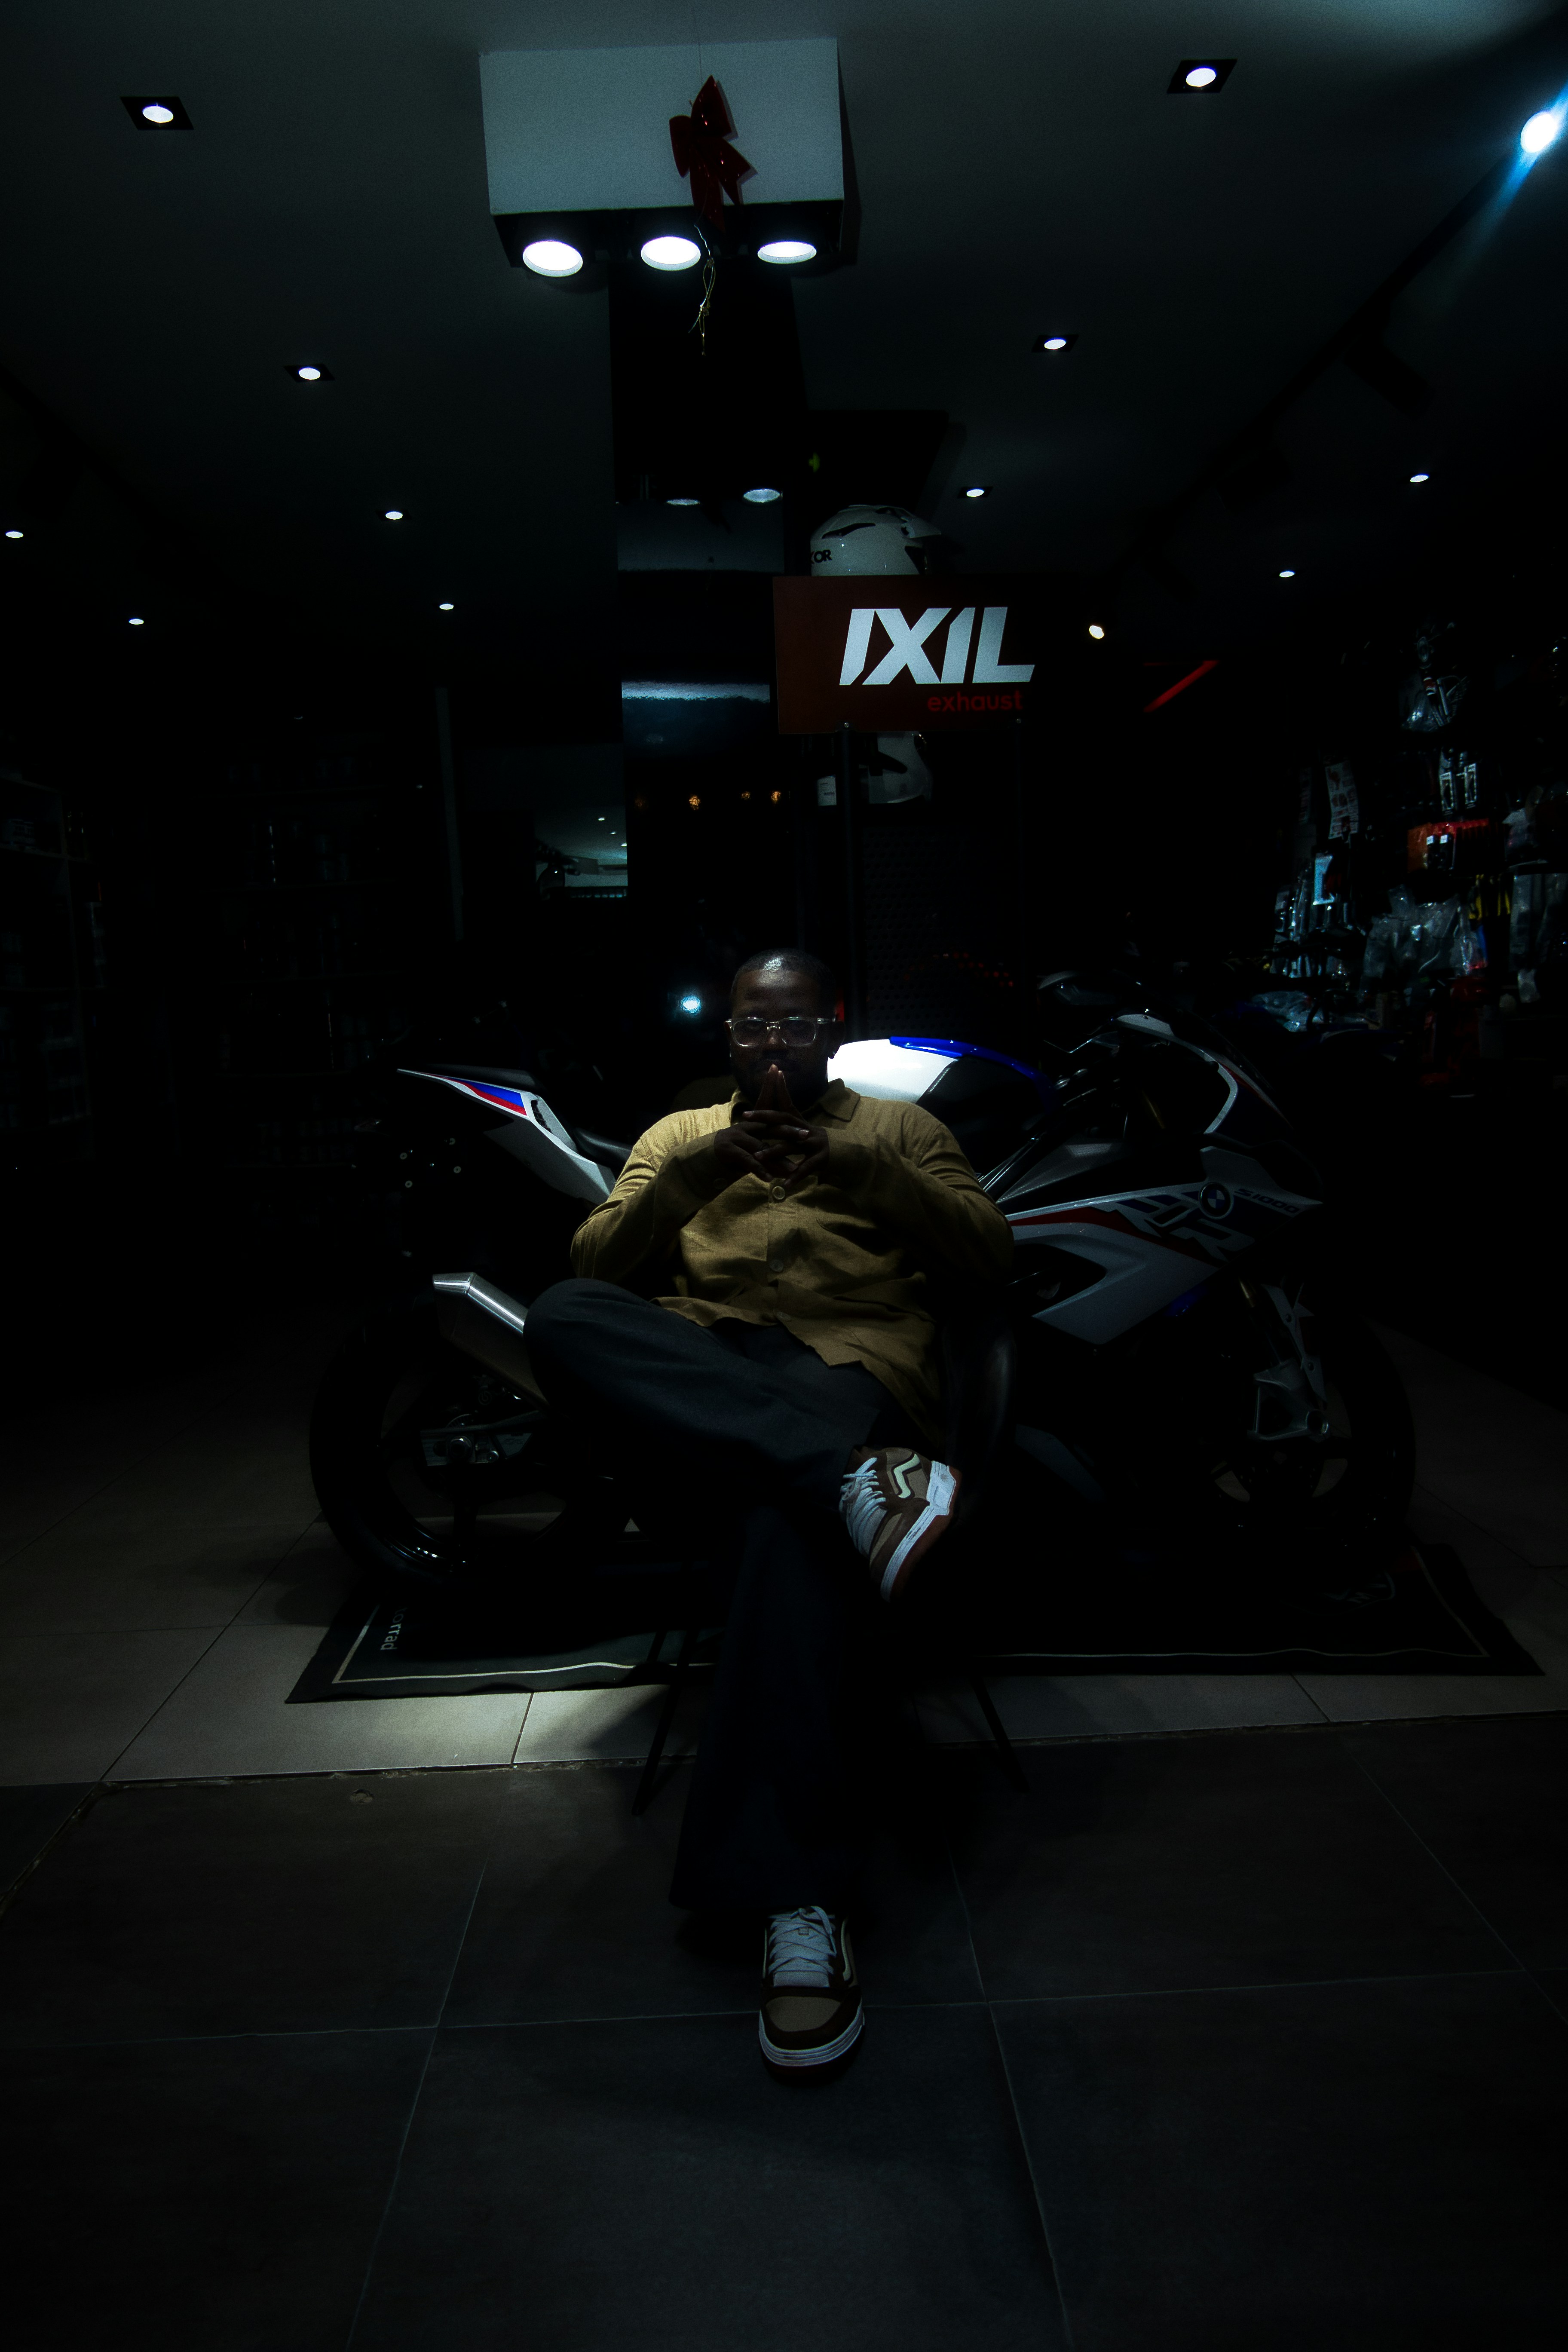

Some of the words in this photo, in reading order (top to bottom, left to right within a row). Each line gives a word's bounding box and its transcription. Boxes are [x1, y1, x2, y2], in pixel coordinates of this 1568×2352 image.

[839, 606, 1035, 685] IXIL
[927, 690, 1024, 712] exhaust
[1234, 1188, 1300, 1214] S1000
[380, 1605, 410, 1651] torrad
